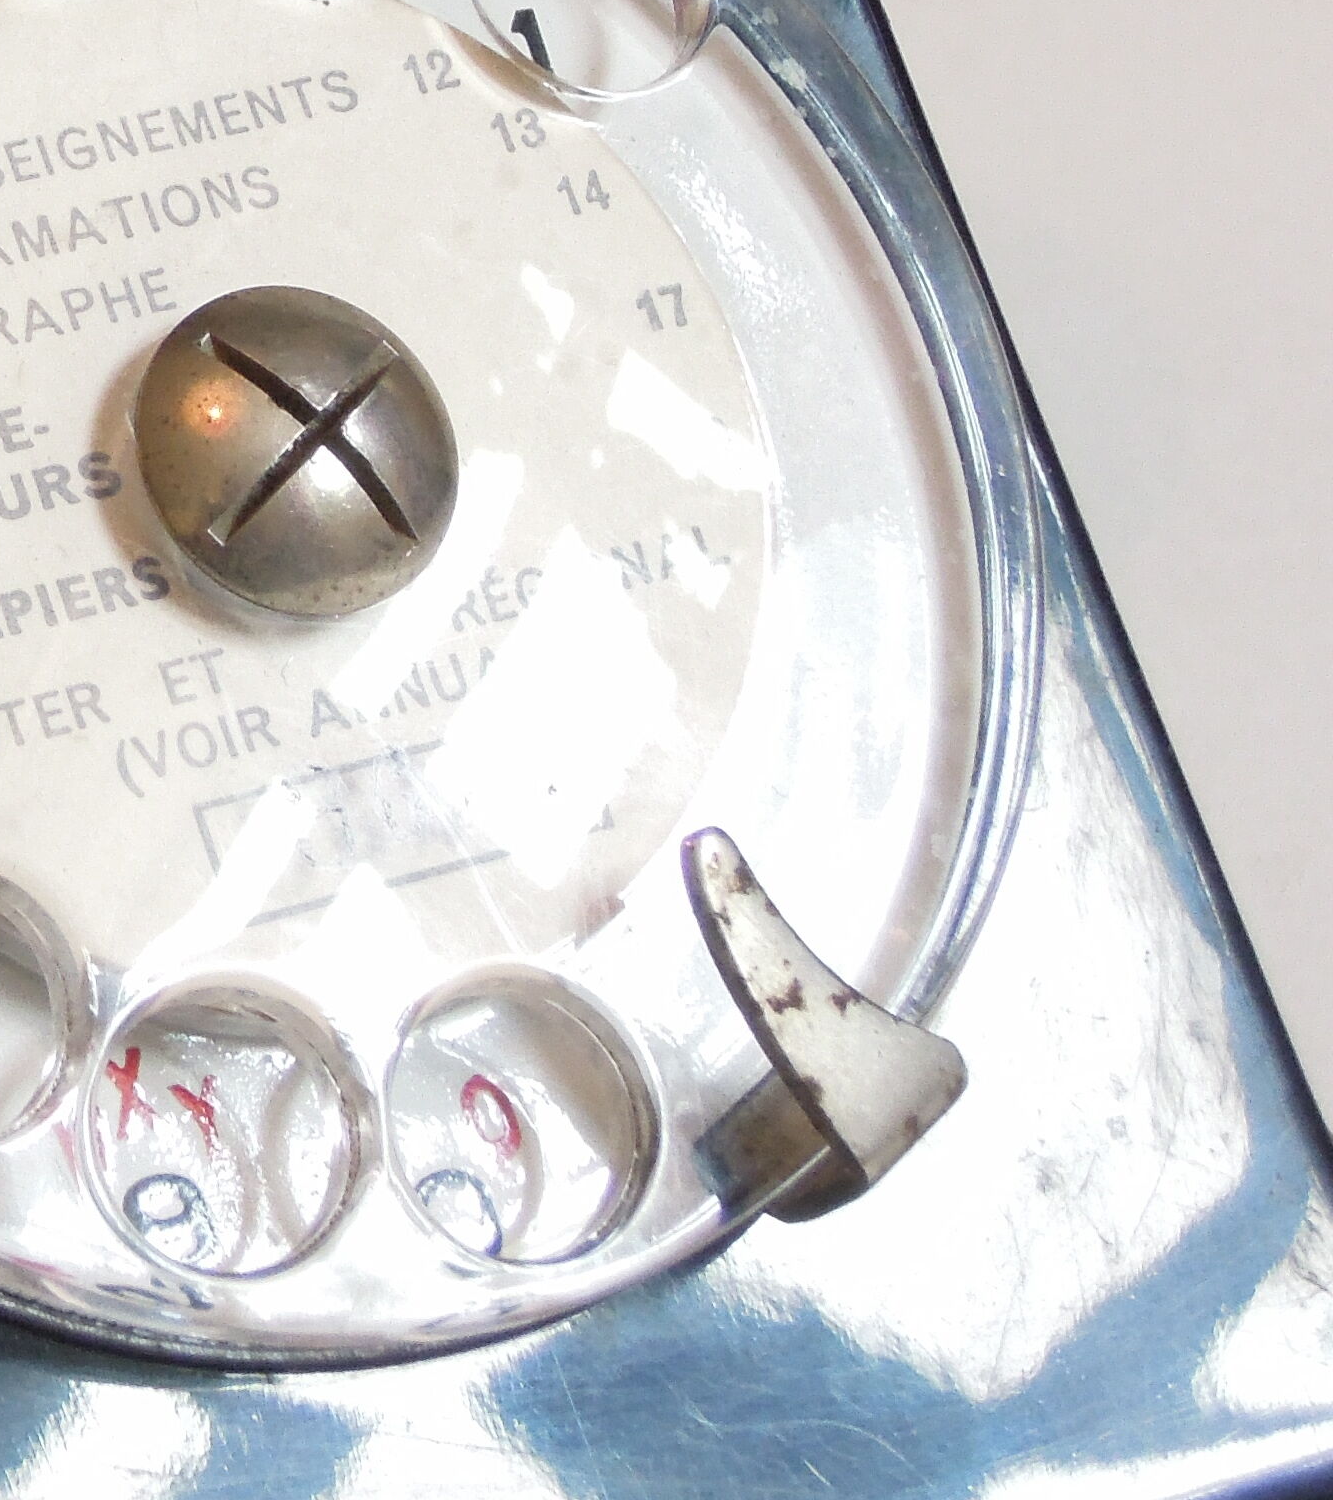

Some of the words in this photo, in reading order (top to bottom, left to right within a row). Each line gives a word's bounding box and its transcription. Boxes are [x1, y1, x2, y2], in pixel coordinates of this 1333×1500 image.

[510, 7, 554, 77] 1
[403, 48, 462, 95] 12
[491, 107, 547, 153] 13
[556, 168, 611, 216] 14
[636, 282, 688, 332] 17
[157, 647, 225, 706] ET
[114, 705, 282, 799] (VOIR
